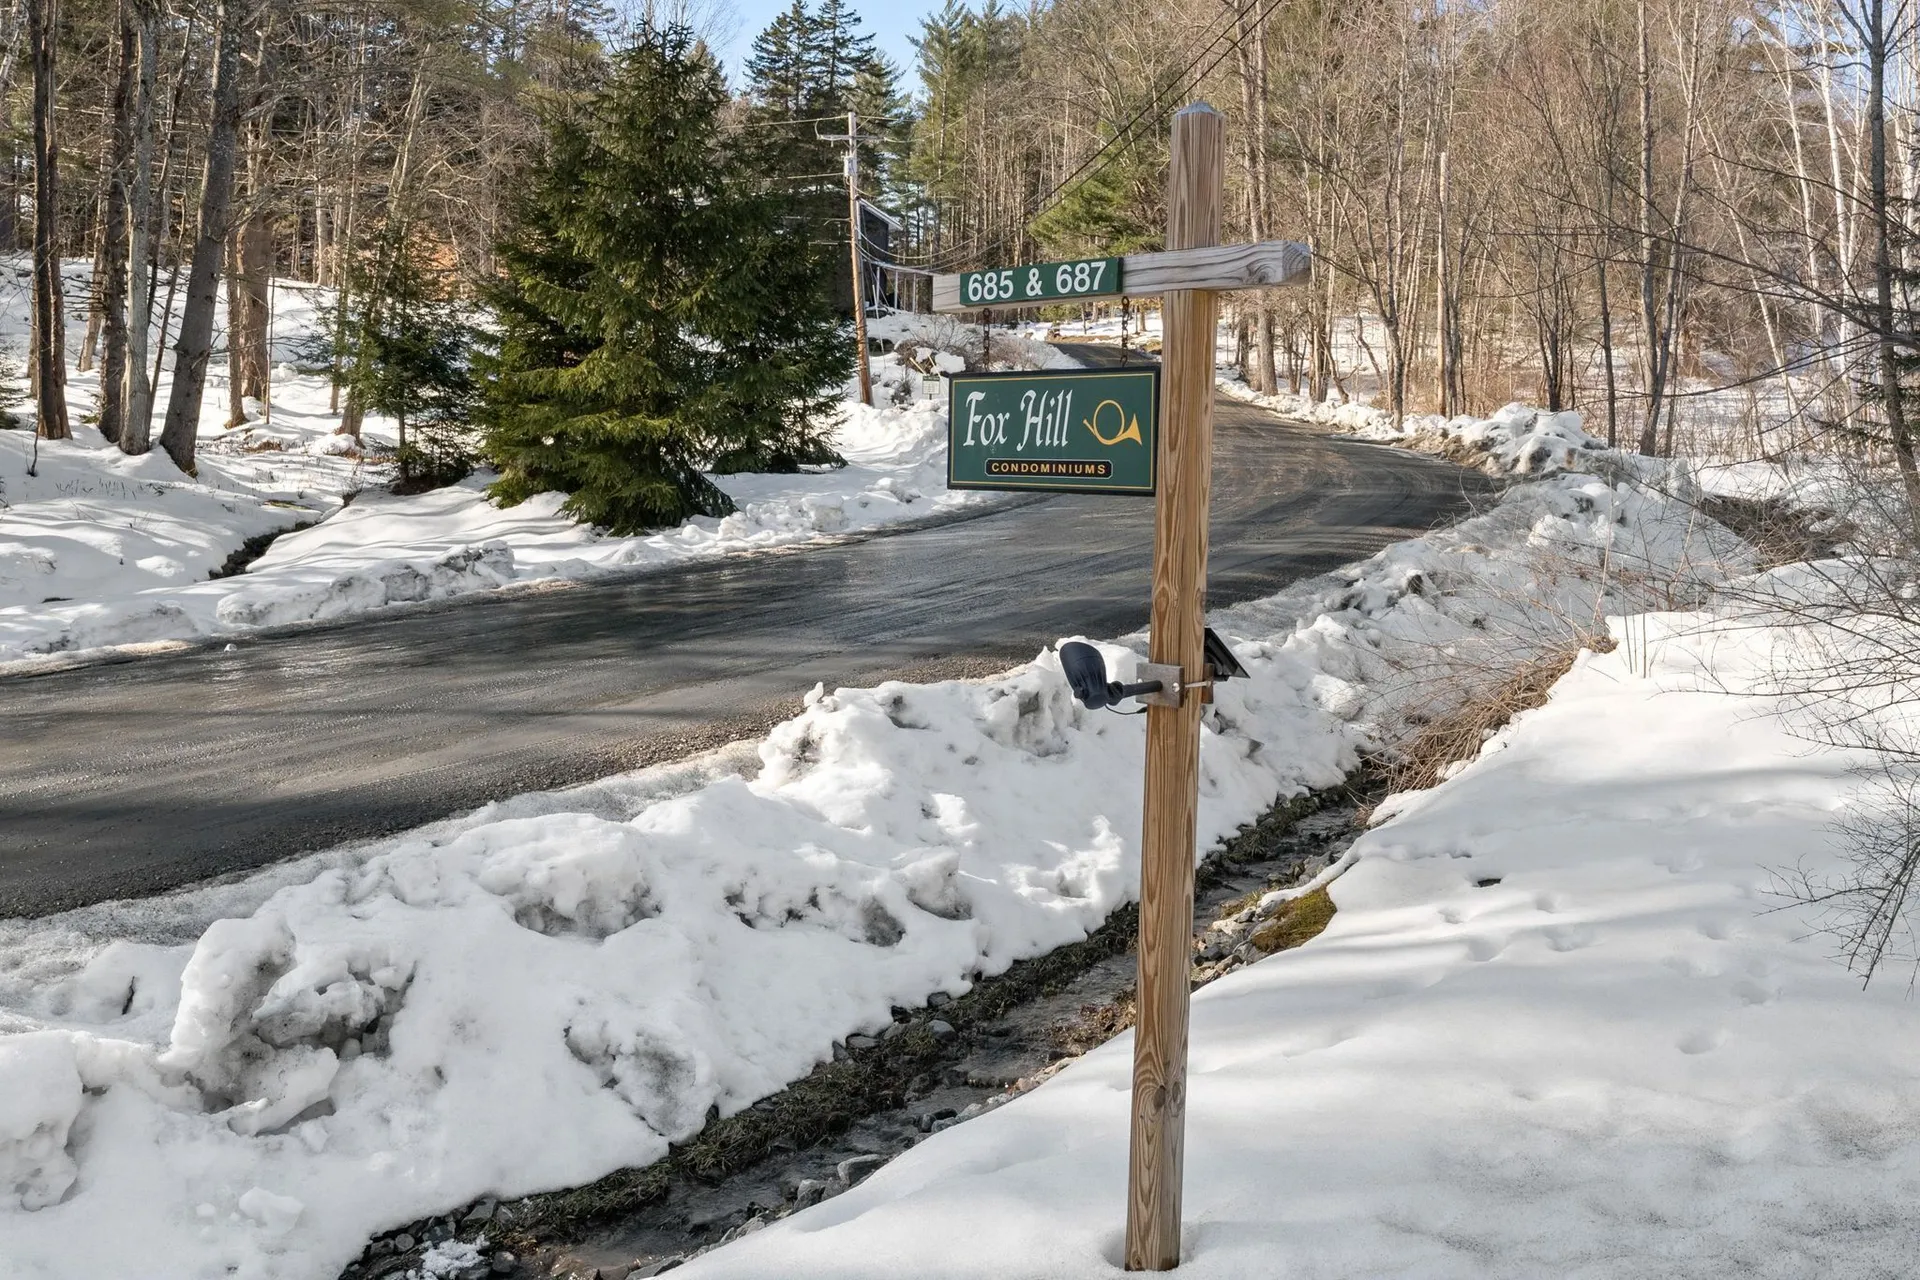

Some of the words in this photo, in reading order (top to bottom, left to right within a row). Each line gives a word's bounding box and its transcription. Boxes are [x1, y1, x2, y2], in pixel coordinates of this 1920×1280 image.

[968, 271, 1013, 301] 685
[1026, 268, 1043, 296] &
[1056, 261, 1106, 293] 687
[963, 391, 1010, 447] Fox
[1017, 389, 1073, 451] Hill
[991, 463, 1106, 475] CONDOMINIUMS
